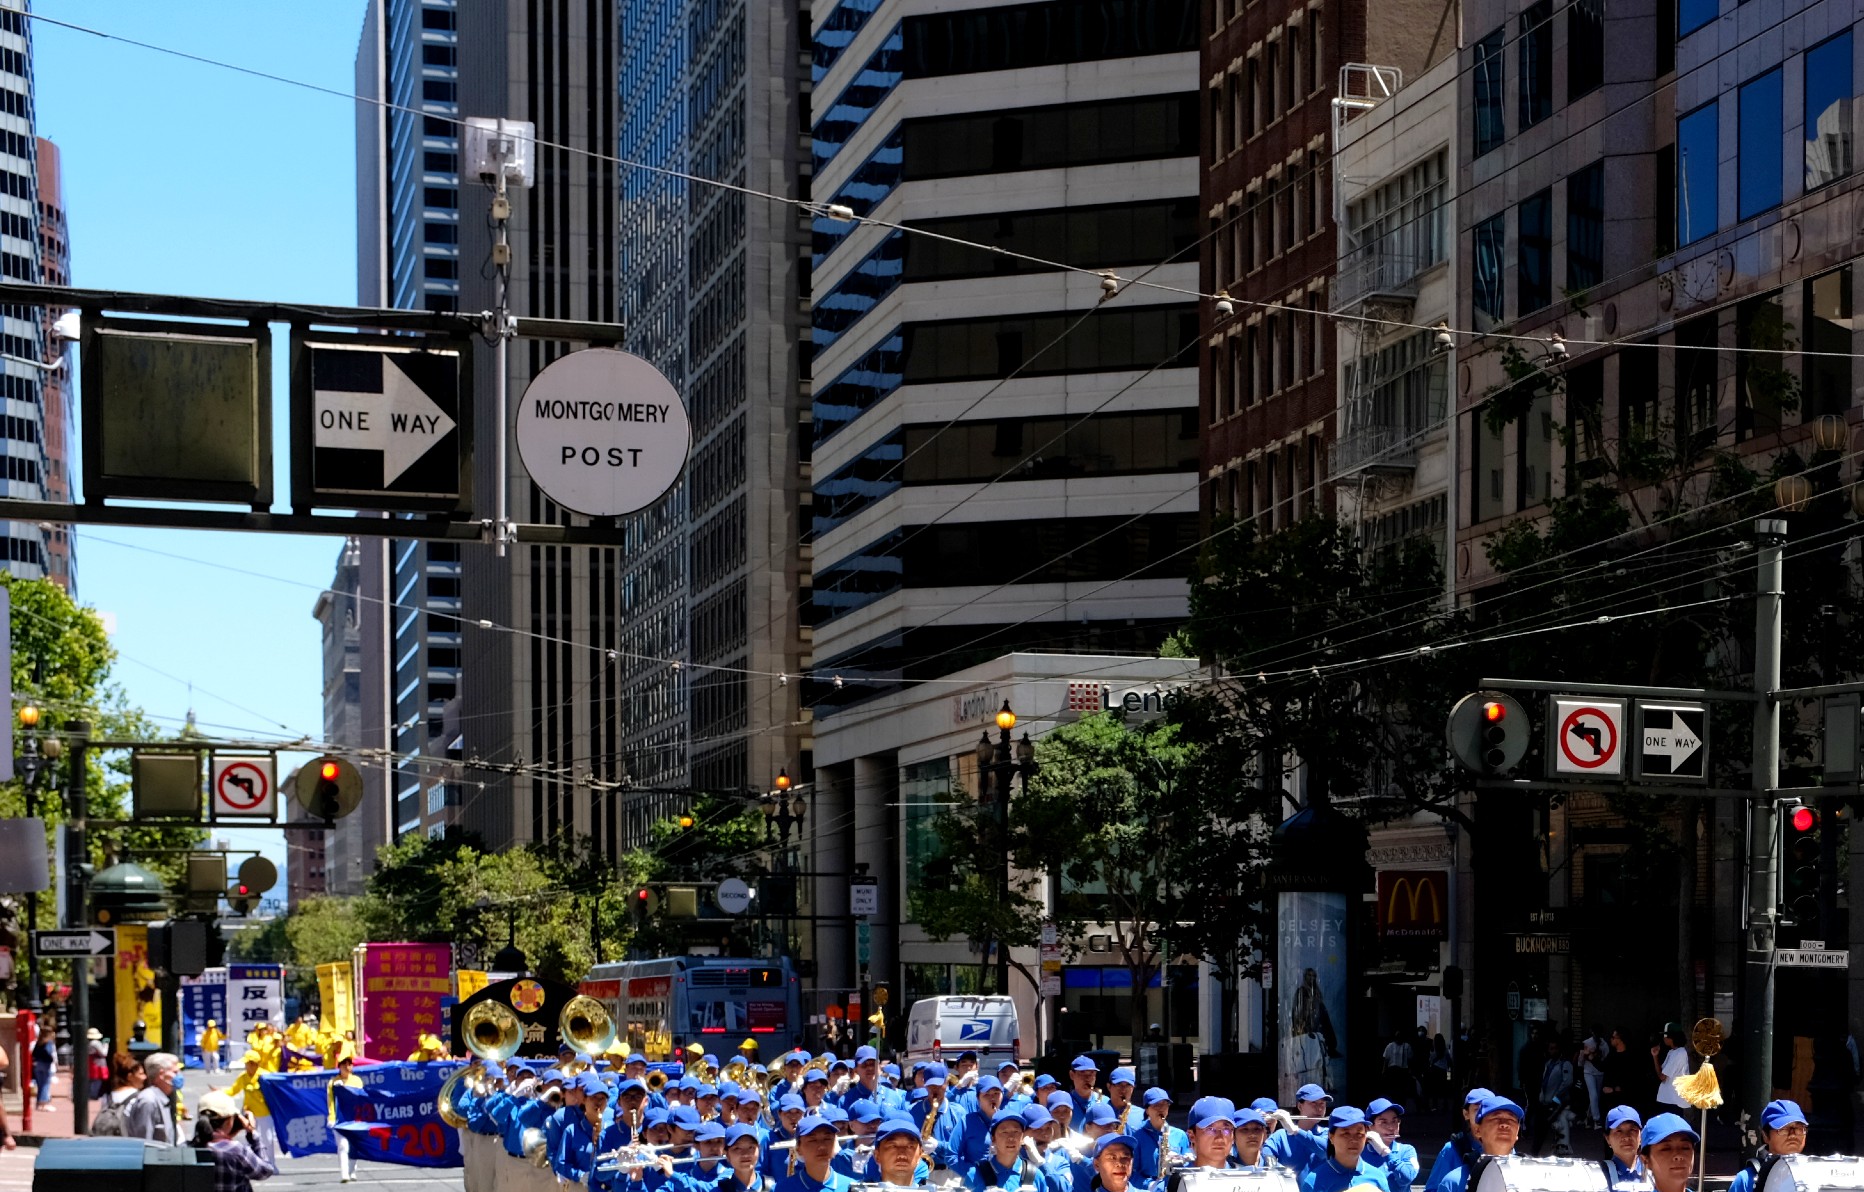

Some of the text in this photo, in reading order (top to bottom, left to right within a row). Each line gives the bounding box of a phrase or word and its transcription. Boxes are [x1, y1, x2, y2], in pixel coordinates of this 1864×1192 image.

[535, 399, 670, 424] MONTGOMERY
[320, 409, 440, 435] ONE WAY
[561, 446, 643, 468] POST
[1645, 736, 1697, 749] ONE WAY
[721, 891, 747, 900] SECOND
[1279, 919, 1343, 932] DELSEY
[1386, 928, 1443, 936] McDonald's
[44, 939, 90, 948] ONE WAY
[1284, 936, 1336, 948] PARIS
[1515, 937, 1558, 953] BUCKHORN
[1780, 953, 1845, 964] NEW MONTGOMERY
[762, 971, 769, 981] 7
[401, 1068, 425, 1081] the
[419, 1102, 433, 1116] OF
